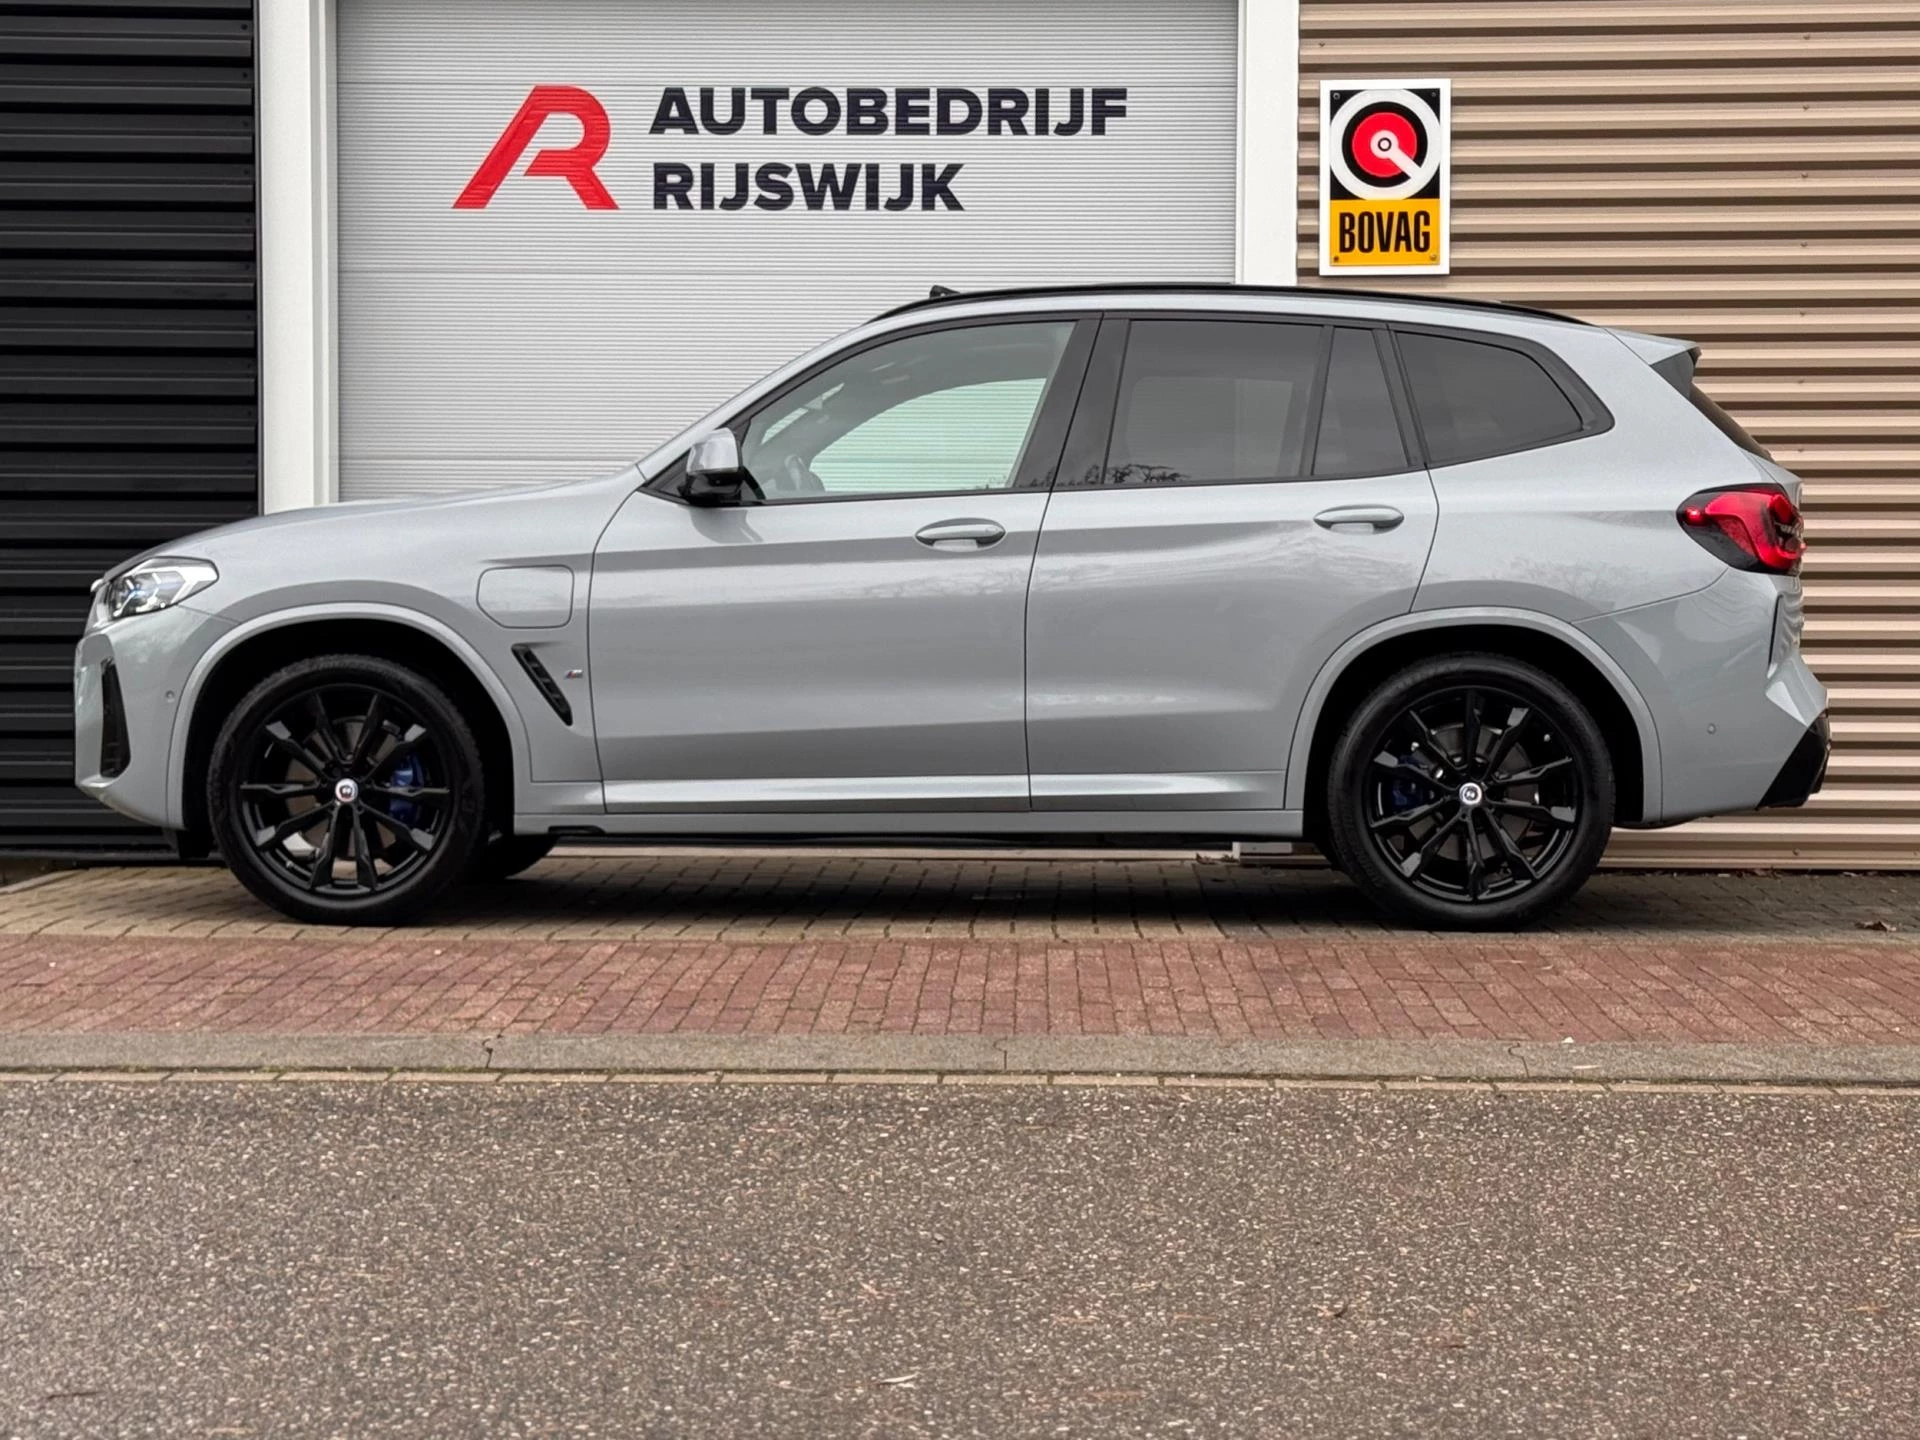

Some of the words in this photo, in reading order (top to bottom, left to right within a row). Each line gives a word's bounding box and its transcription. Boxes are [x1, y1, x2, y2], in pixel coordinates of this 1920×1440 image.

[649, 87, 1128, 136] AUTOBEDRIJF
[653, 162, 965, 211] RIJSWIJK
[1339, 210, 1431, 254] BOVAG
